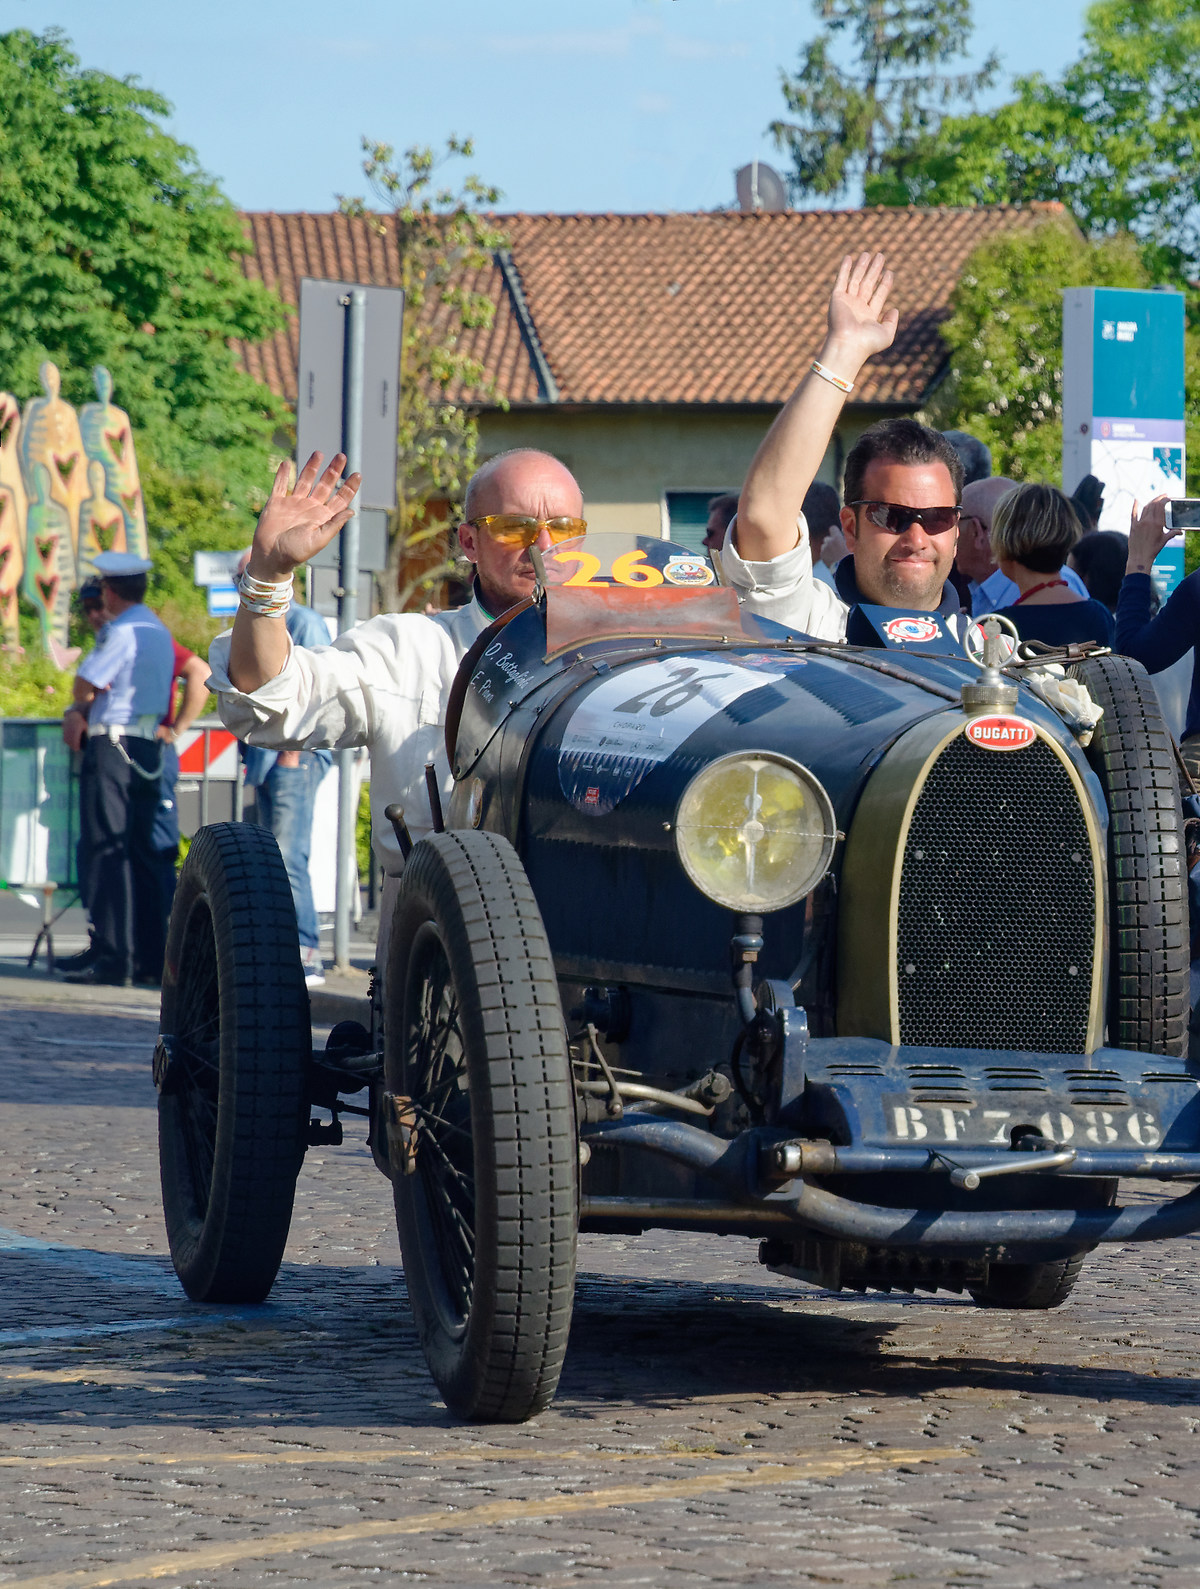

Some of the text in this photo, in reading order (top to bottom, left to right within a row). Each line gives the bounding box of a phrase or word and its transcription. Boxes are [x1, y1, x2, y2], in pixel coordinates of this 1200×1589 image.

[552, 550, 664, 588] 26
[613, 667, 734, 717] 26
[973, 726, 1029, 741] BUGATTI
